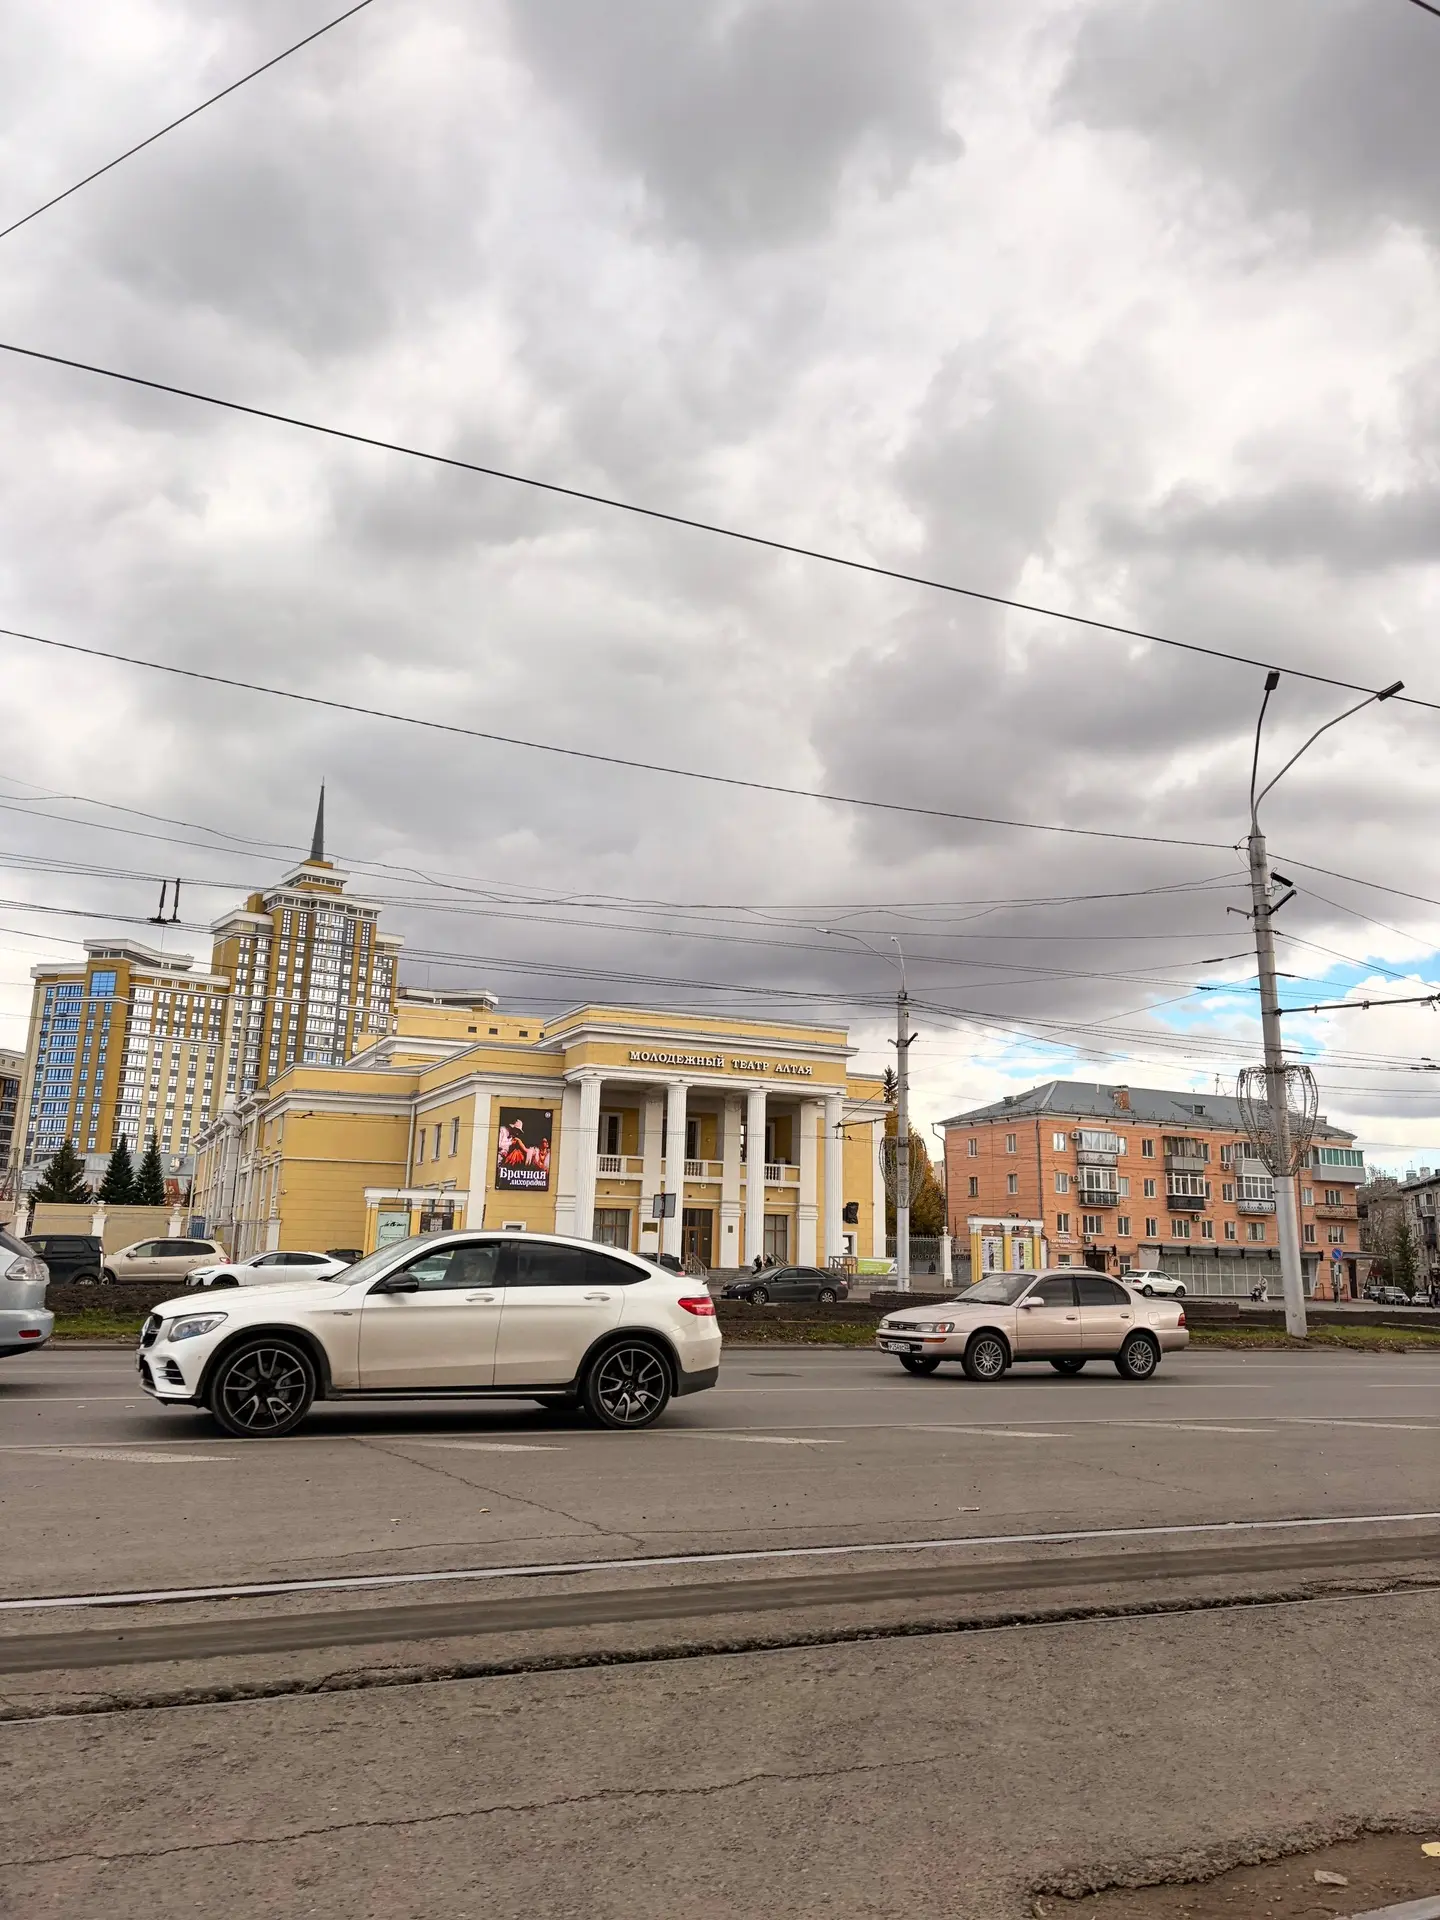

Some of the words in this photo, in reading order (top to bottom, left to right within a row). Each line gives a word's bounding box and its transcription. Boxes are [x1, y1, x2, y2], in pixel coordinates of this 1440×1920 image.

[630, 1050, 725, 1068] МОЛОДЕЖНЫЙ
[732, 1059, 769, 1071] ТЕАТР
[775, 1063, 813, 1075] АЛТАЯ
[499, 1167, 546, 1181] Брачная
